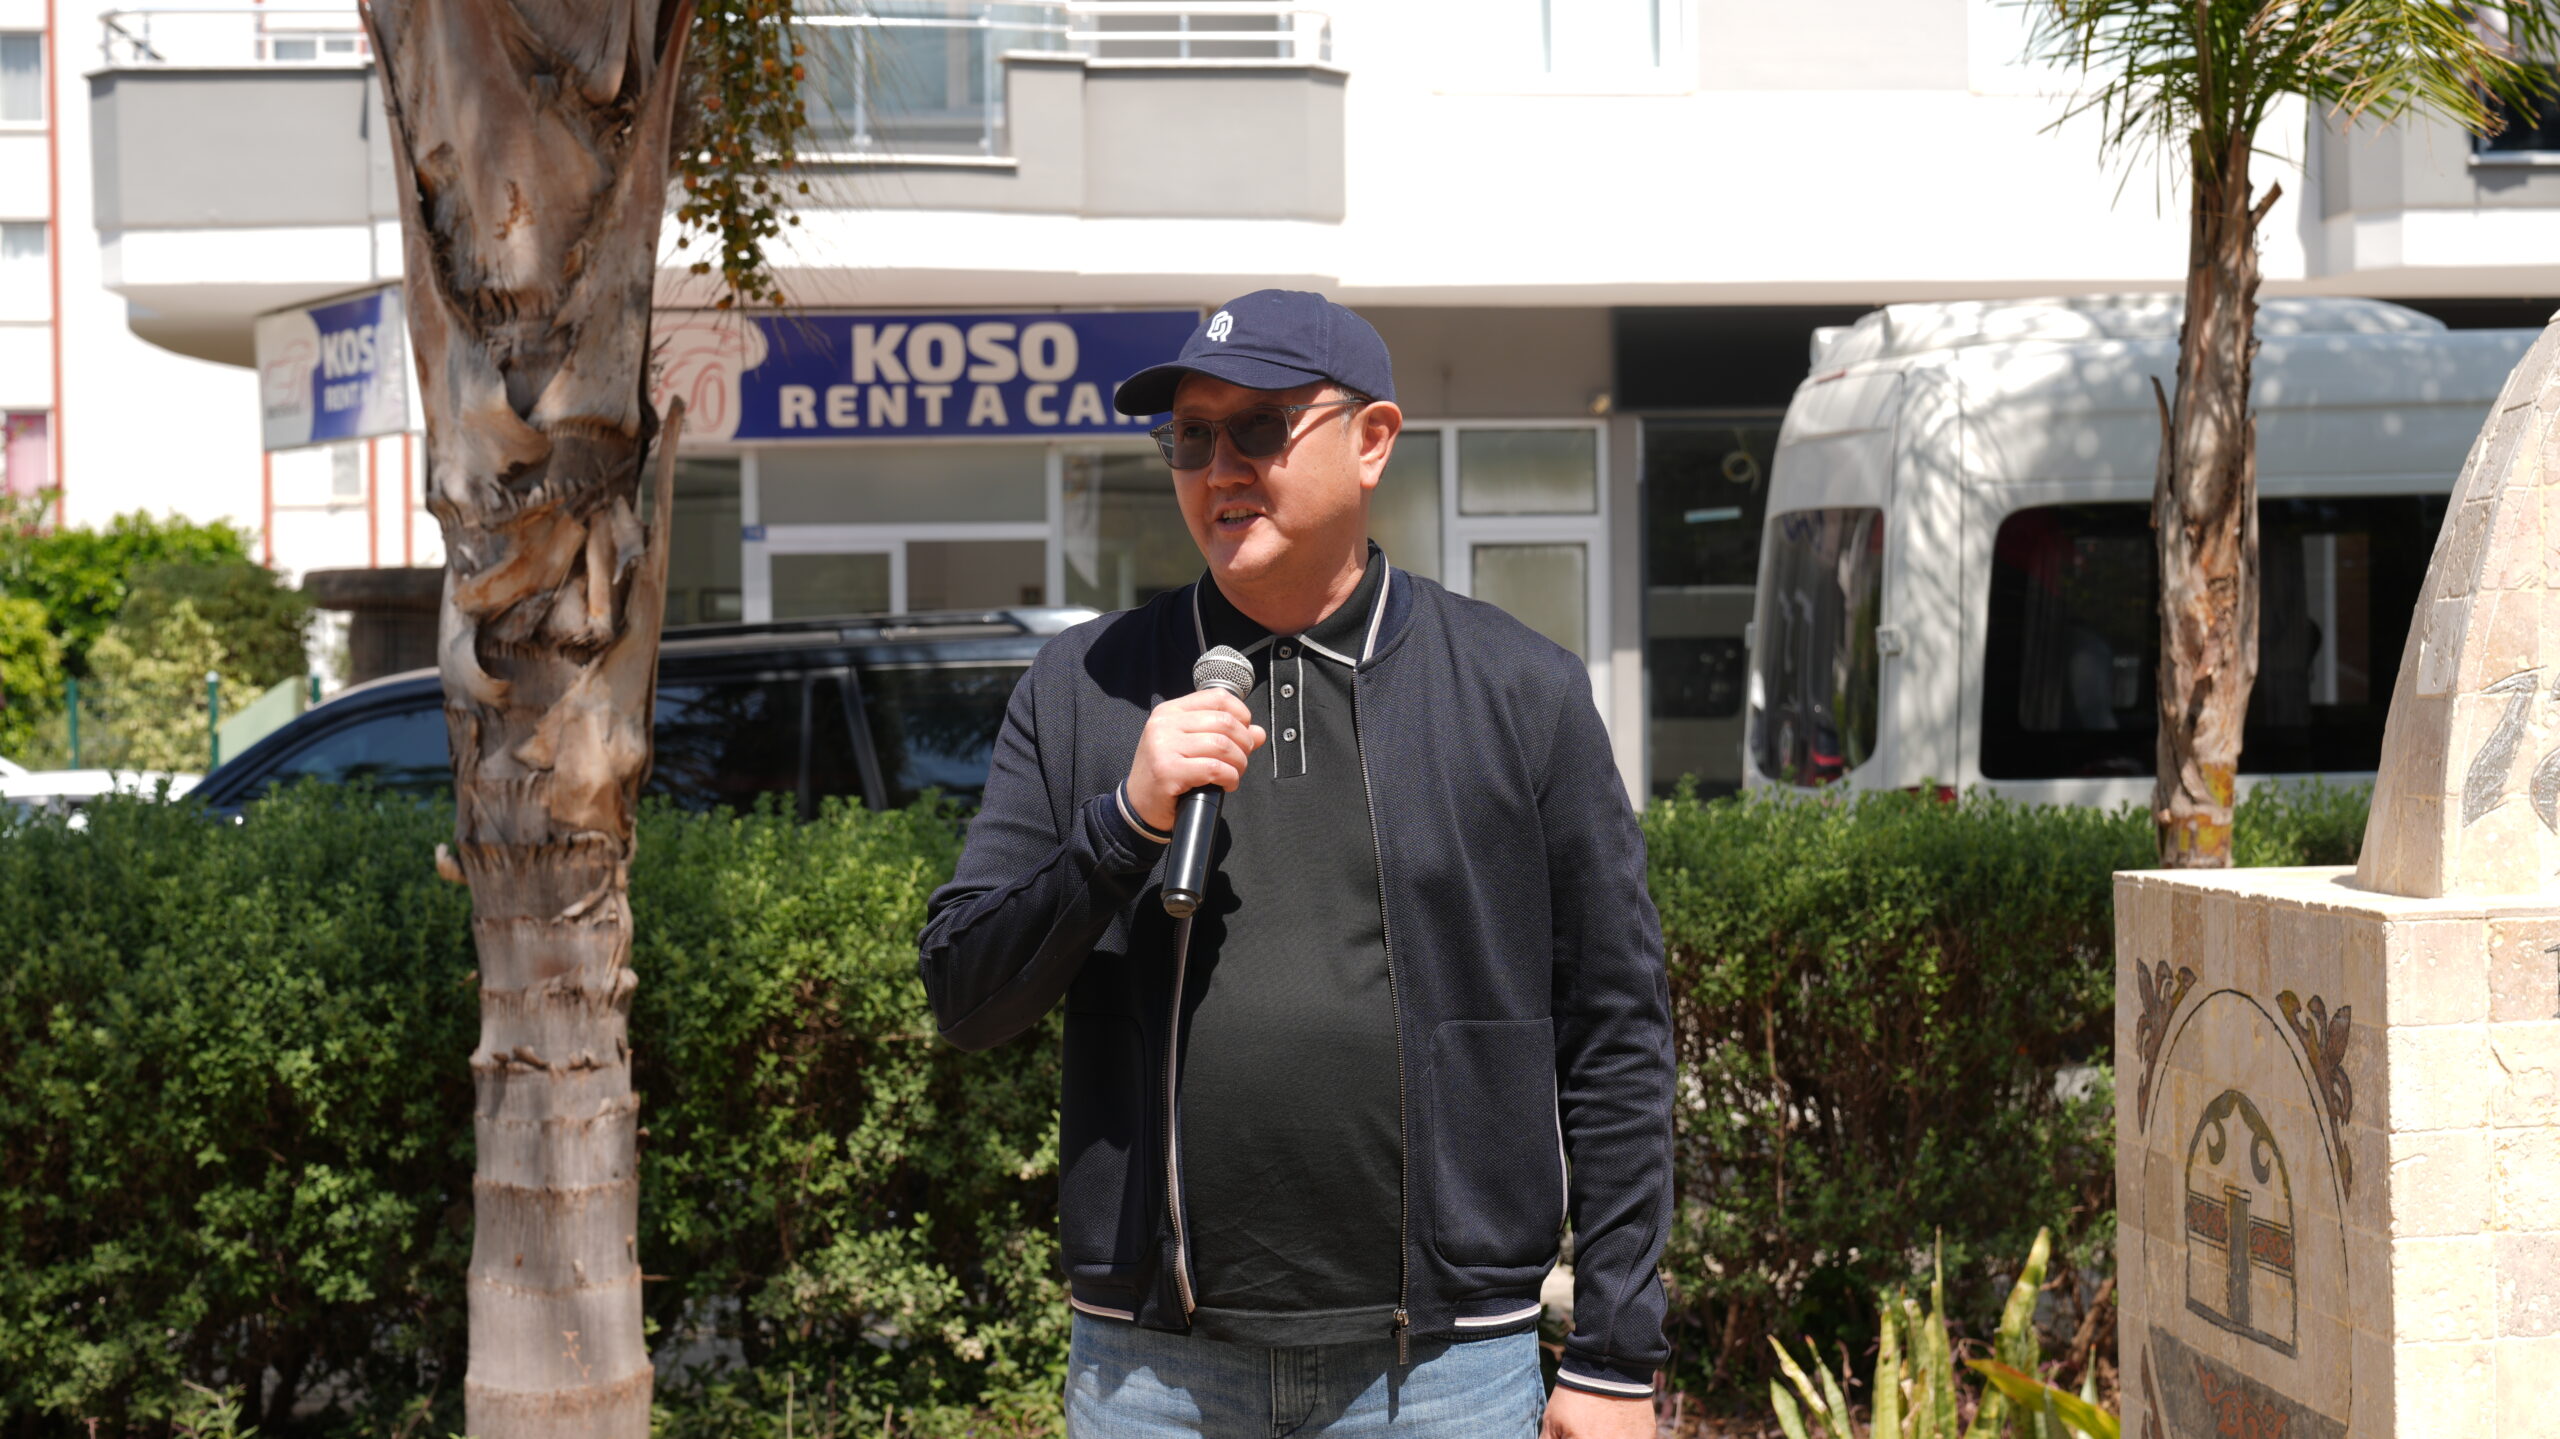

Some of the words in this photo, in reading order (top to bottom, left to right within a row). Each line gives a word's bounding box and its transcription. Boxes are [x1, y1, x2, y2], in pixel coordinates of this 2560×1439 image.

[321, 324, 380, 380] KOS
[852, 322, 1079, 384] KOSO
[779, 384, 953, 428] RENT
[967, 383, 1009, 426] A
